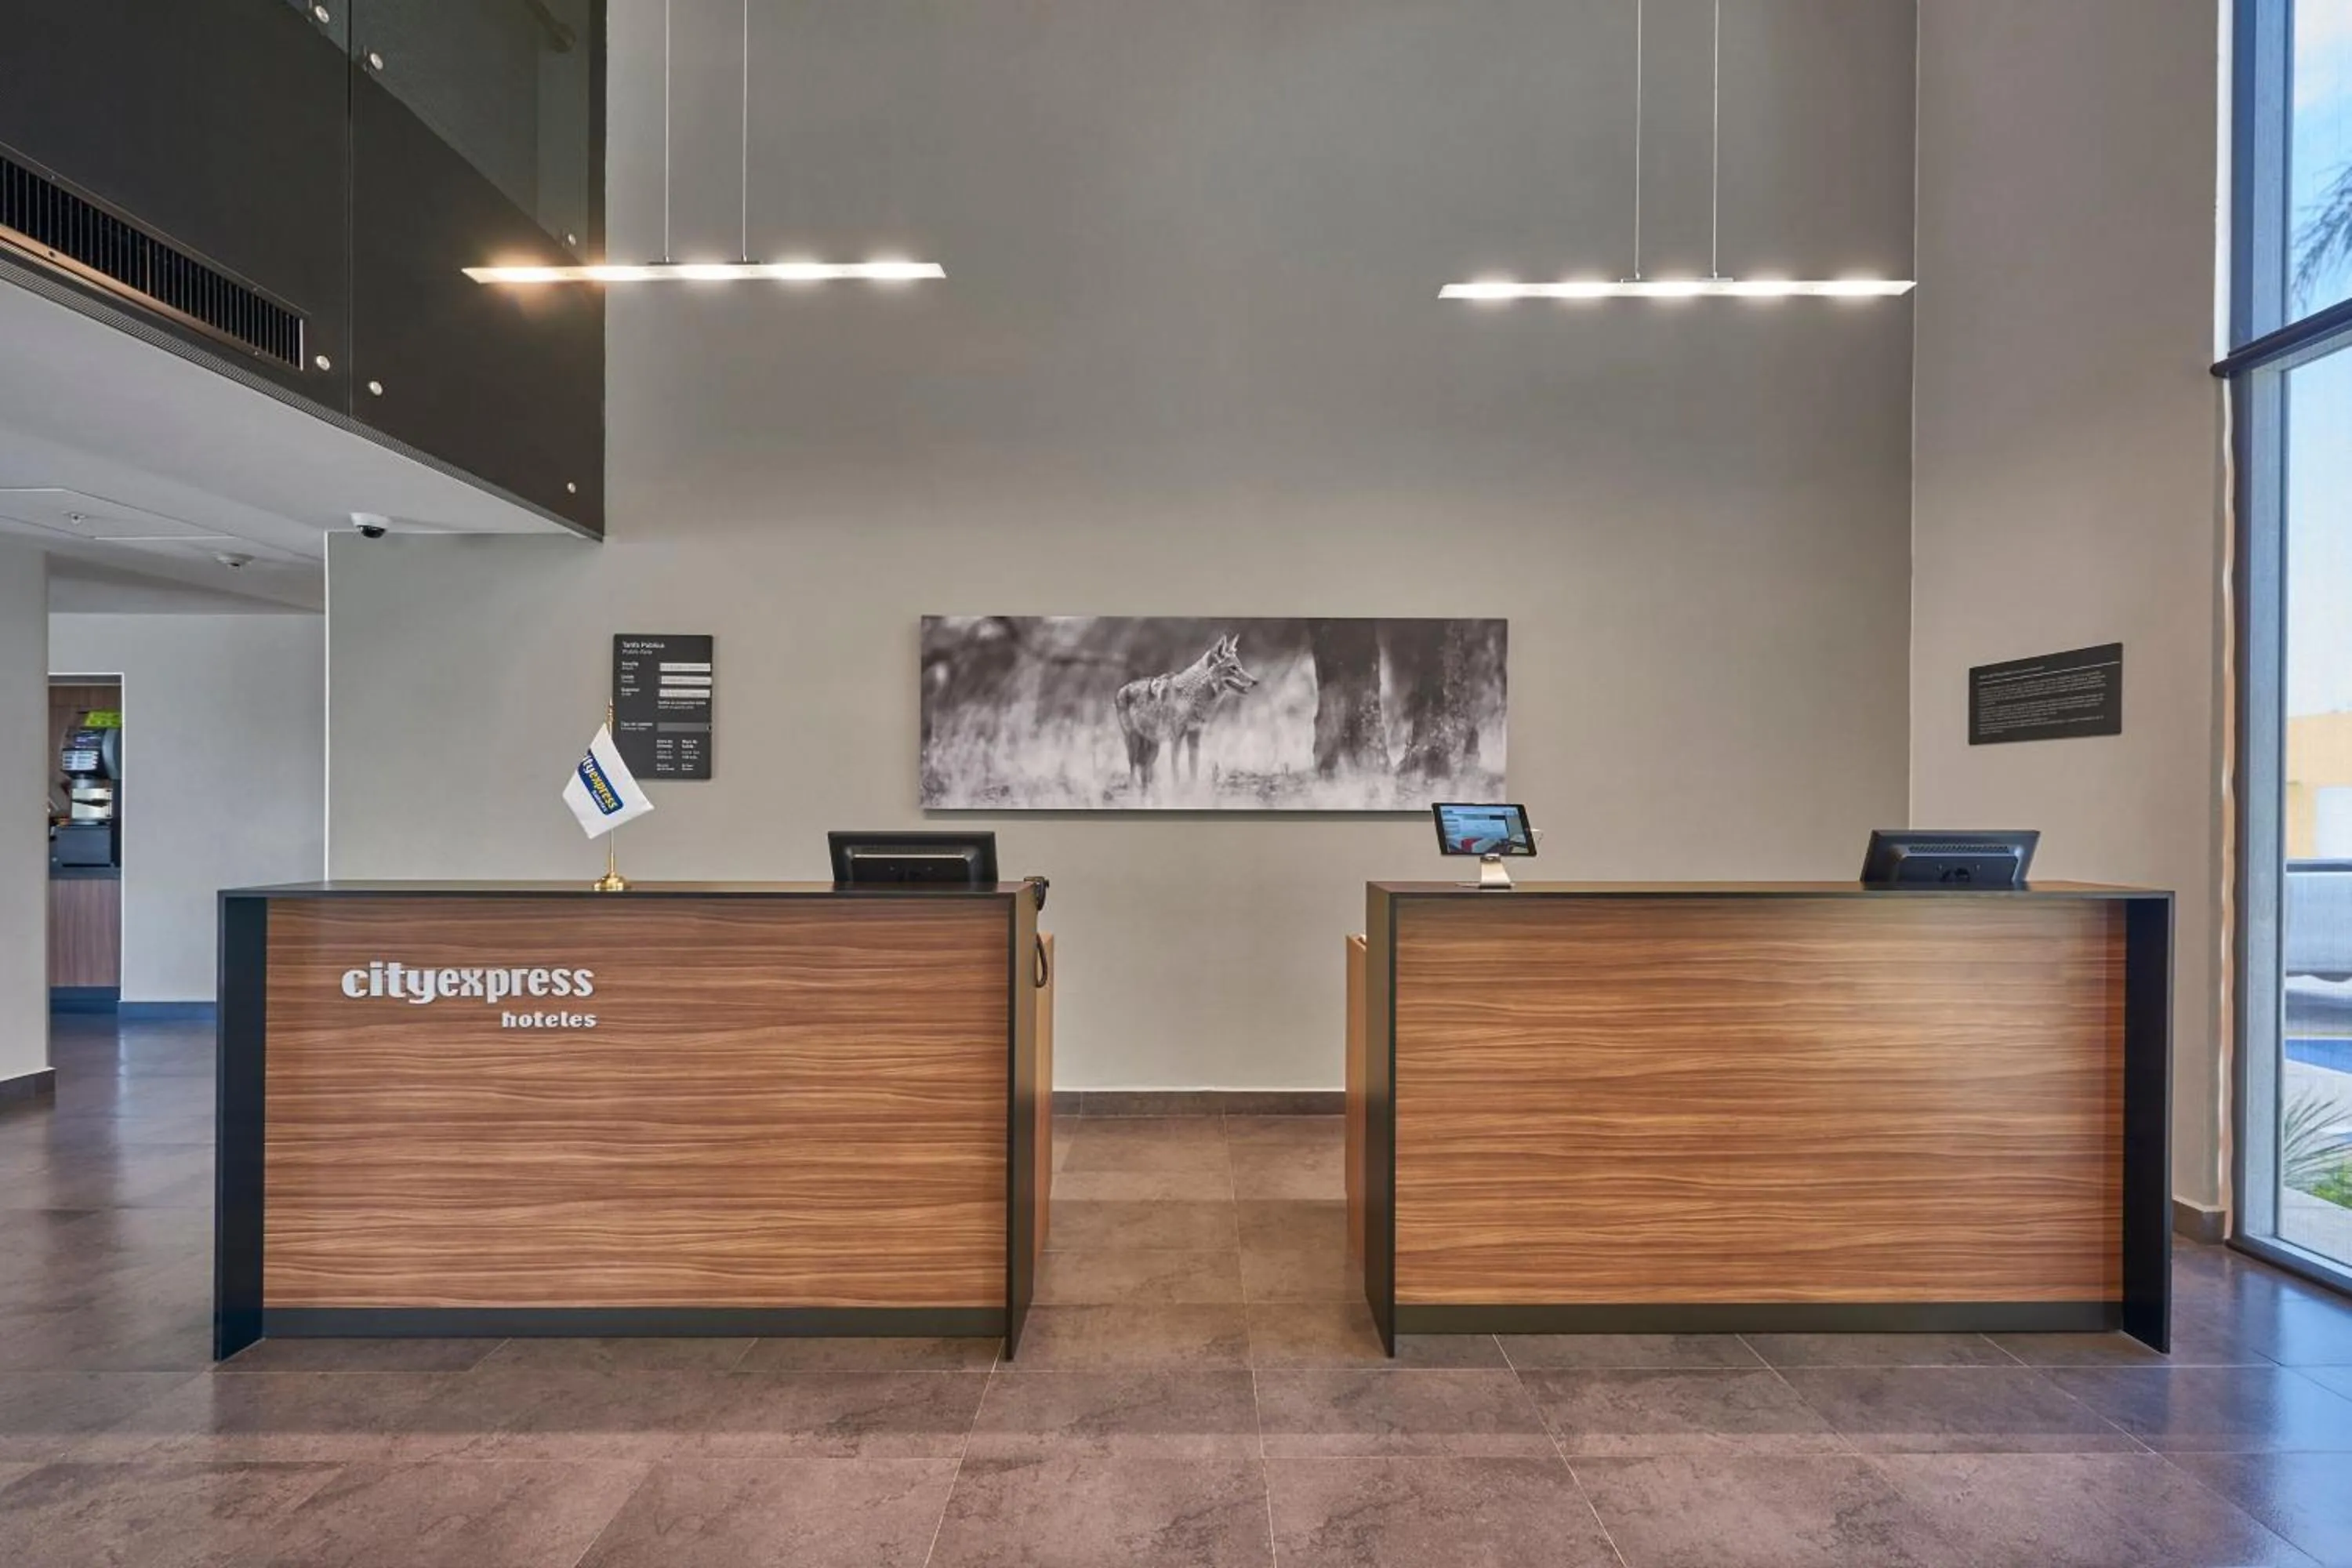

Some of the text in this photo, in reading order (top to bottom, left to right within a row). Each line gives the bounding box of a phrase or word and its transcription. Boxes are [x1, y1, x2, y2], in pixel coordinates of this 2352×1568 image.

[583, 755, 618, 809] ityexpress
[341, 961, 594, 1004] cityexpress
[501, 1011, 597, 1029] hoteles
